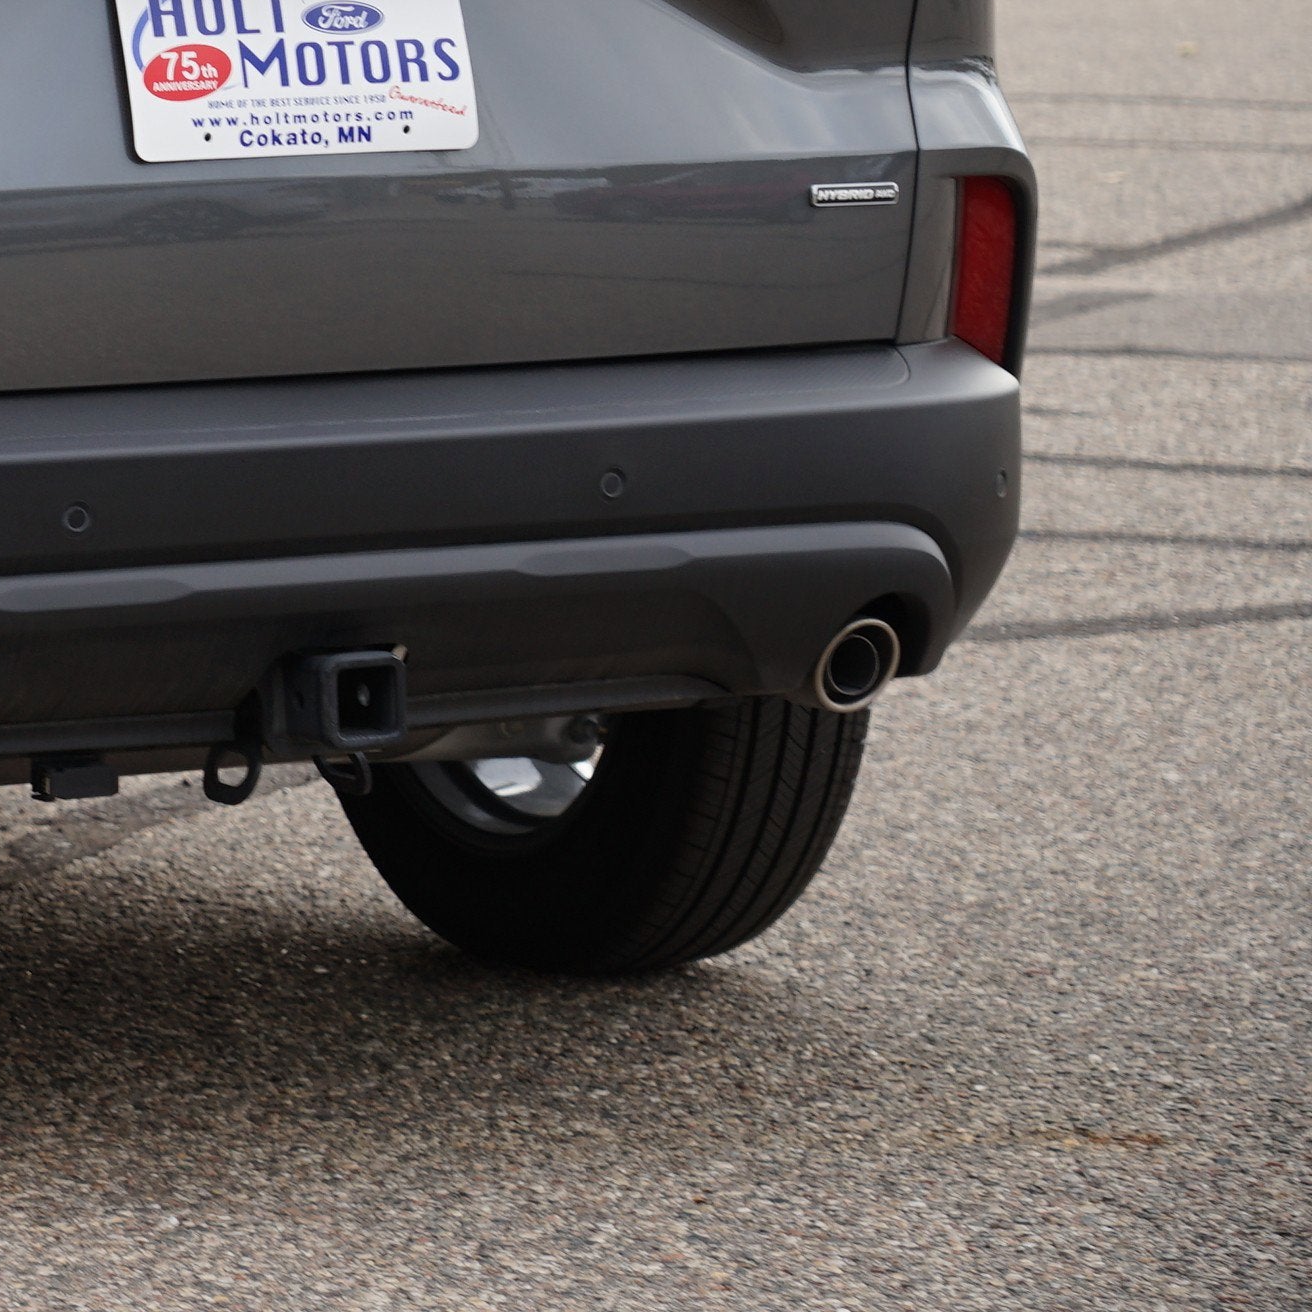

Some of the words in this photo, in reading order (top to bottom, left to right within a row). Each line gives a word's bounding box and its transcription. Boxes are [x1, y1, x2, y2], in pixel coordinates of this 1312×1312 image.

[318, 4, 369, 30] Ford
[160, 50, 219, 81] 75th
[237, 37, 461, 88] MOTORS
[152, 80, 219, 92] ANNIVERSARY
[270, 98, 292, 107] BEST
[191, 109, 415, 128] www.holtmotors.com
[240, 128, 330, 148] Cokato,
[338, 125, 373, 143] MN
